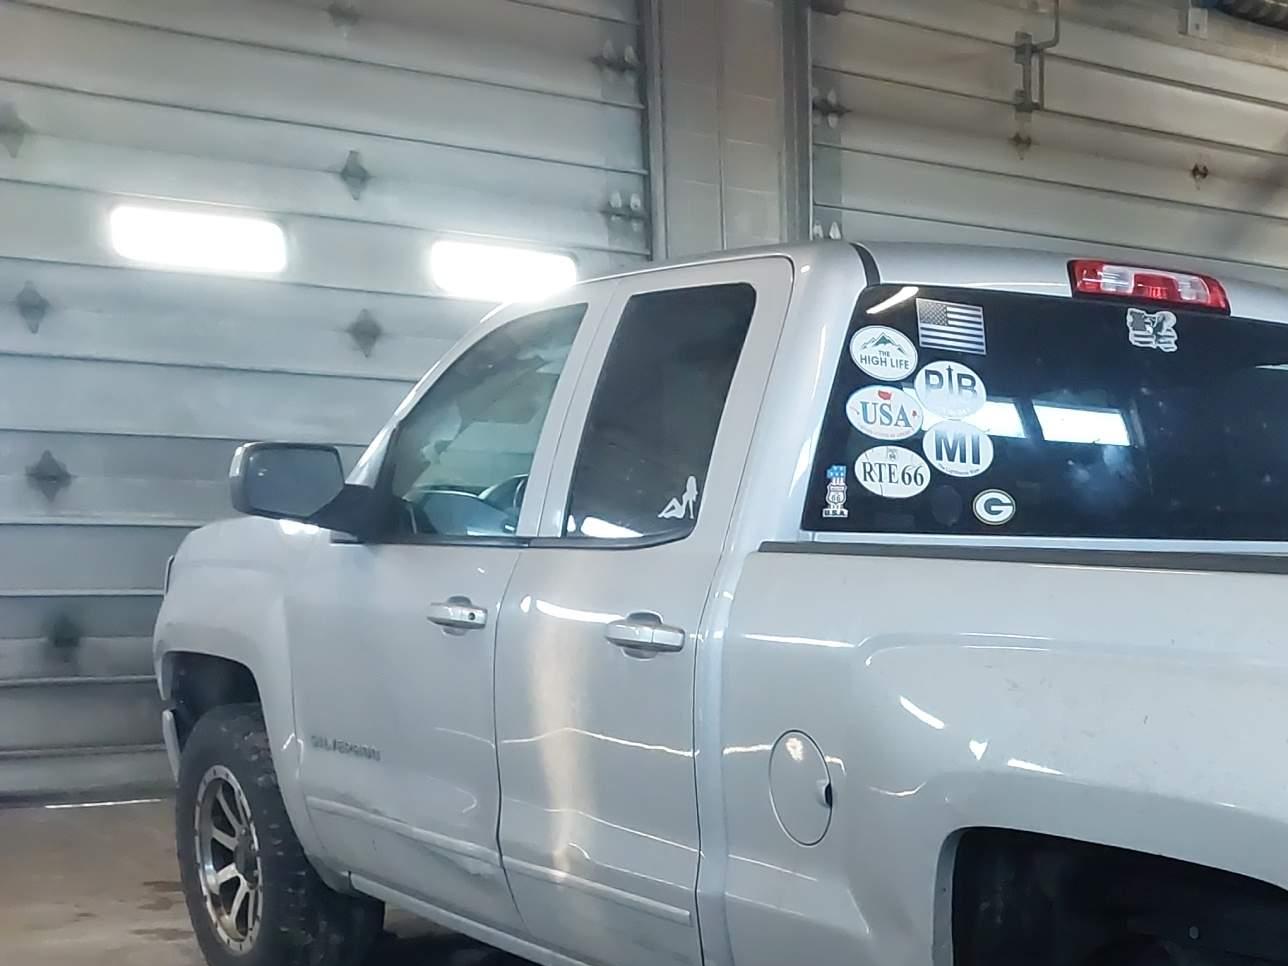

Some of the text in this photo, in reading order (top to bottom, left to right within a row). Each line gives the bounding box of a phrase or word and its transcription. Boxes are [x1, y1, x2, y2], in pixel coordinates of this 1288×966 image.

[859, 354, 910, 370] HIGH LIFE
[860, 400, 912, 428] USA
[934, 429, 981, 465] MI
[862, 460, 899, 485] RTE
[901, 464, 924, 487] 66
